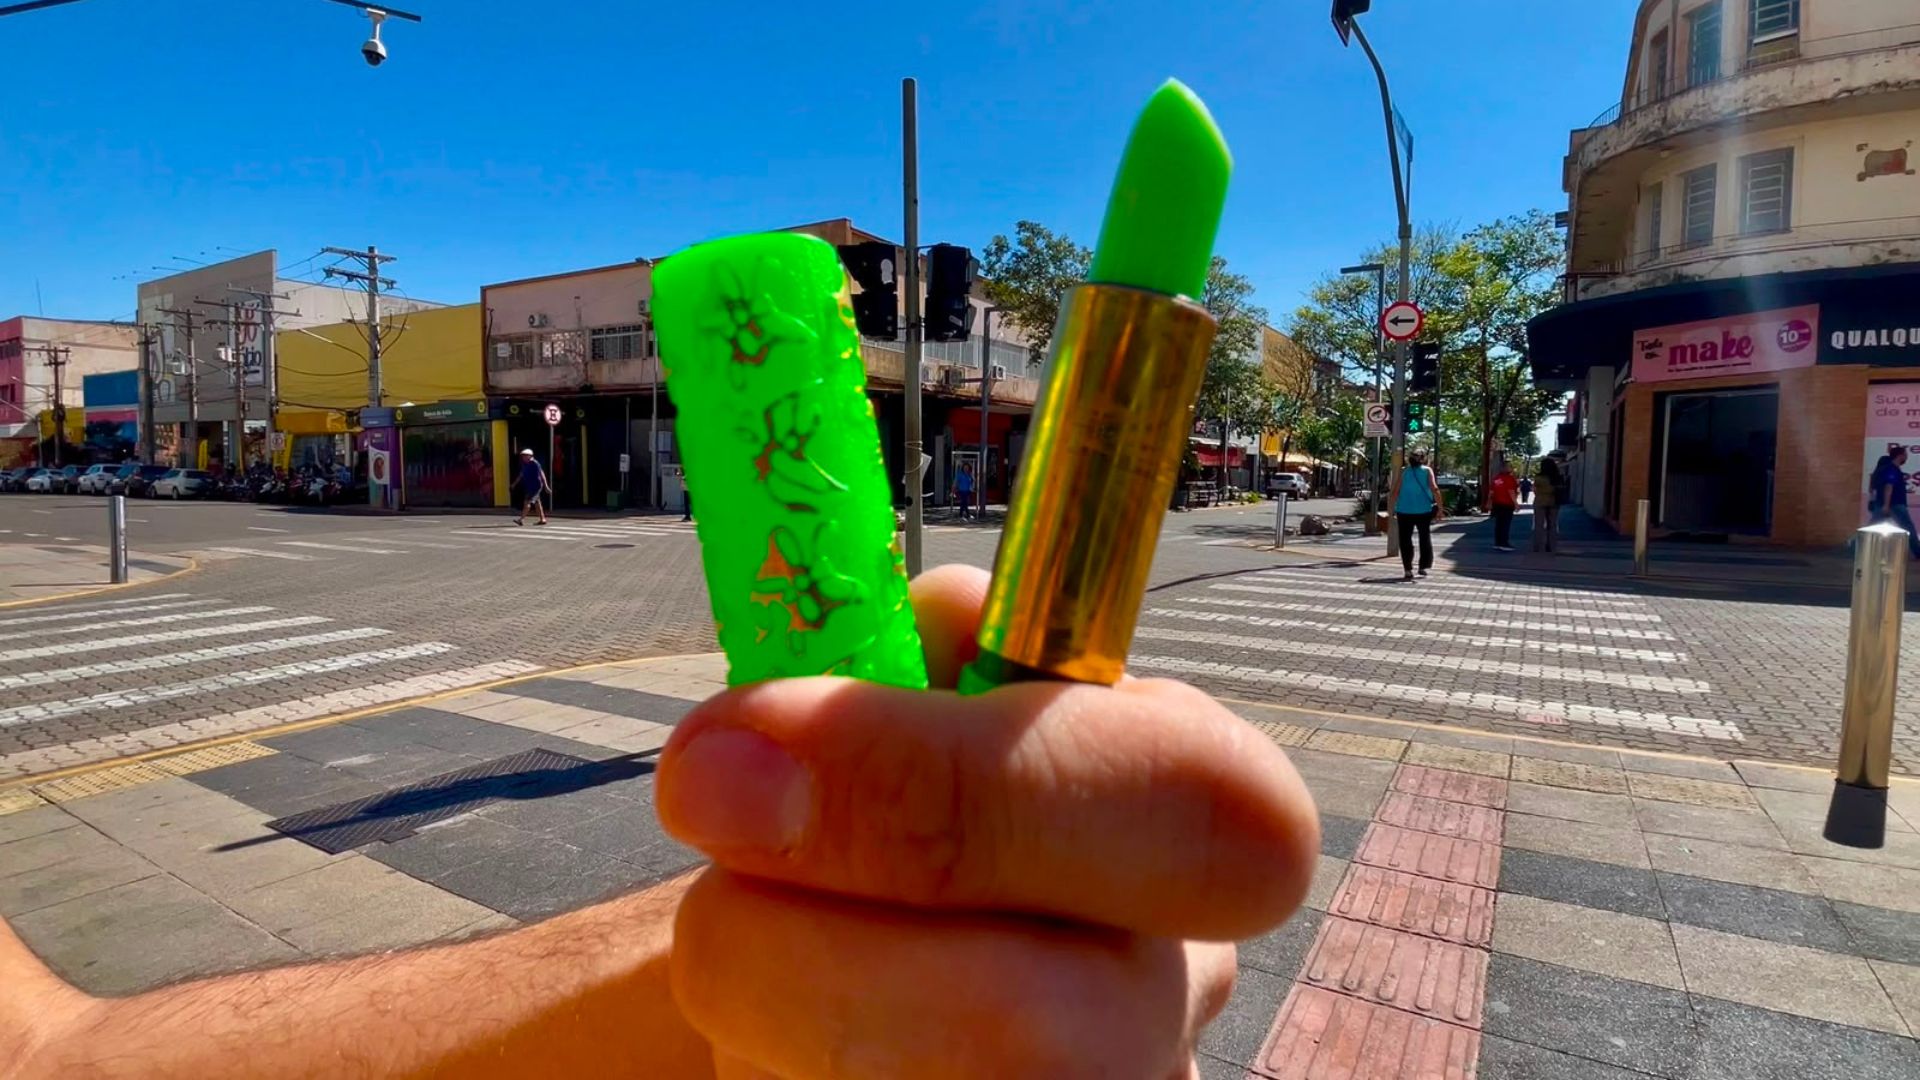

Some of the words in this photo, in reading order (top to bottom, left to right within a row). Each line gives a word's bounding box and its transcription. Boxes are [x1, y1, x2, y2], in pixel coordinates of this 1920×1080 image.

[1780, 330, 1799, 344] 10
[1830, 328, 1920, 349] QUALQU
[1875, 394, 1909, 405] Sua
